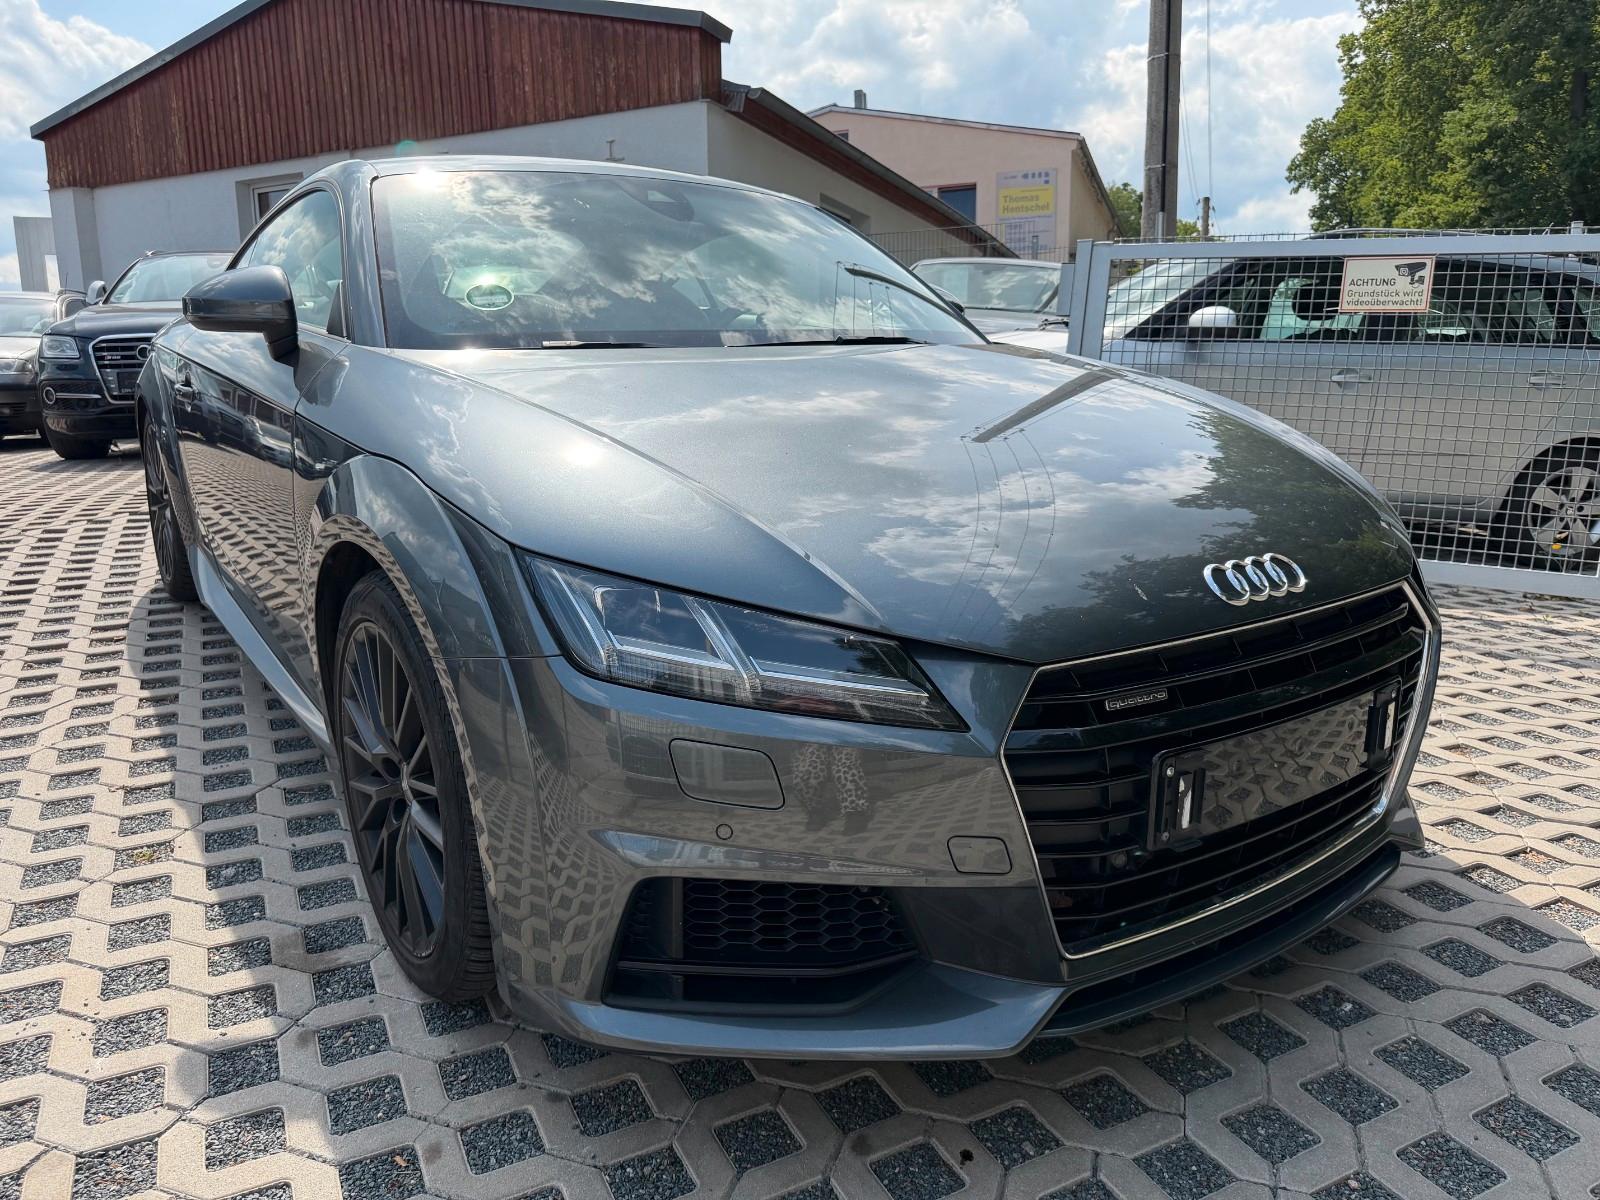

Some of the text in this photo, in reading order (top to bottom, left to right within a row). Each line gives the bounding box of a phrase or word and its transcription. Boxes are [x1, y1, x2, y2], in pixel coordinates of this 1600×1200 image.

[1001, 194, 1040, 203] Thomas
[1002, 201, 1050, 214] Hentschel
[1348, 278, 1397, 287] ACHTUNG
[1347, 289, 1424, 298] Grundstück wird
[1346, 297, 1423, 306] videoüberwacht!
[1109, 690, 1166, 709] quattro
